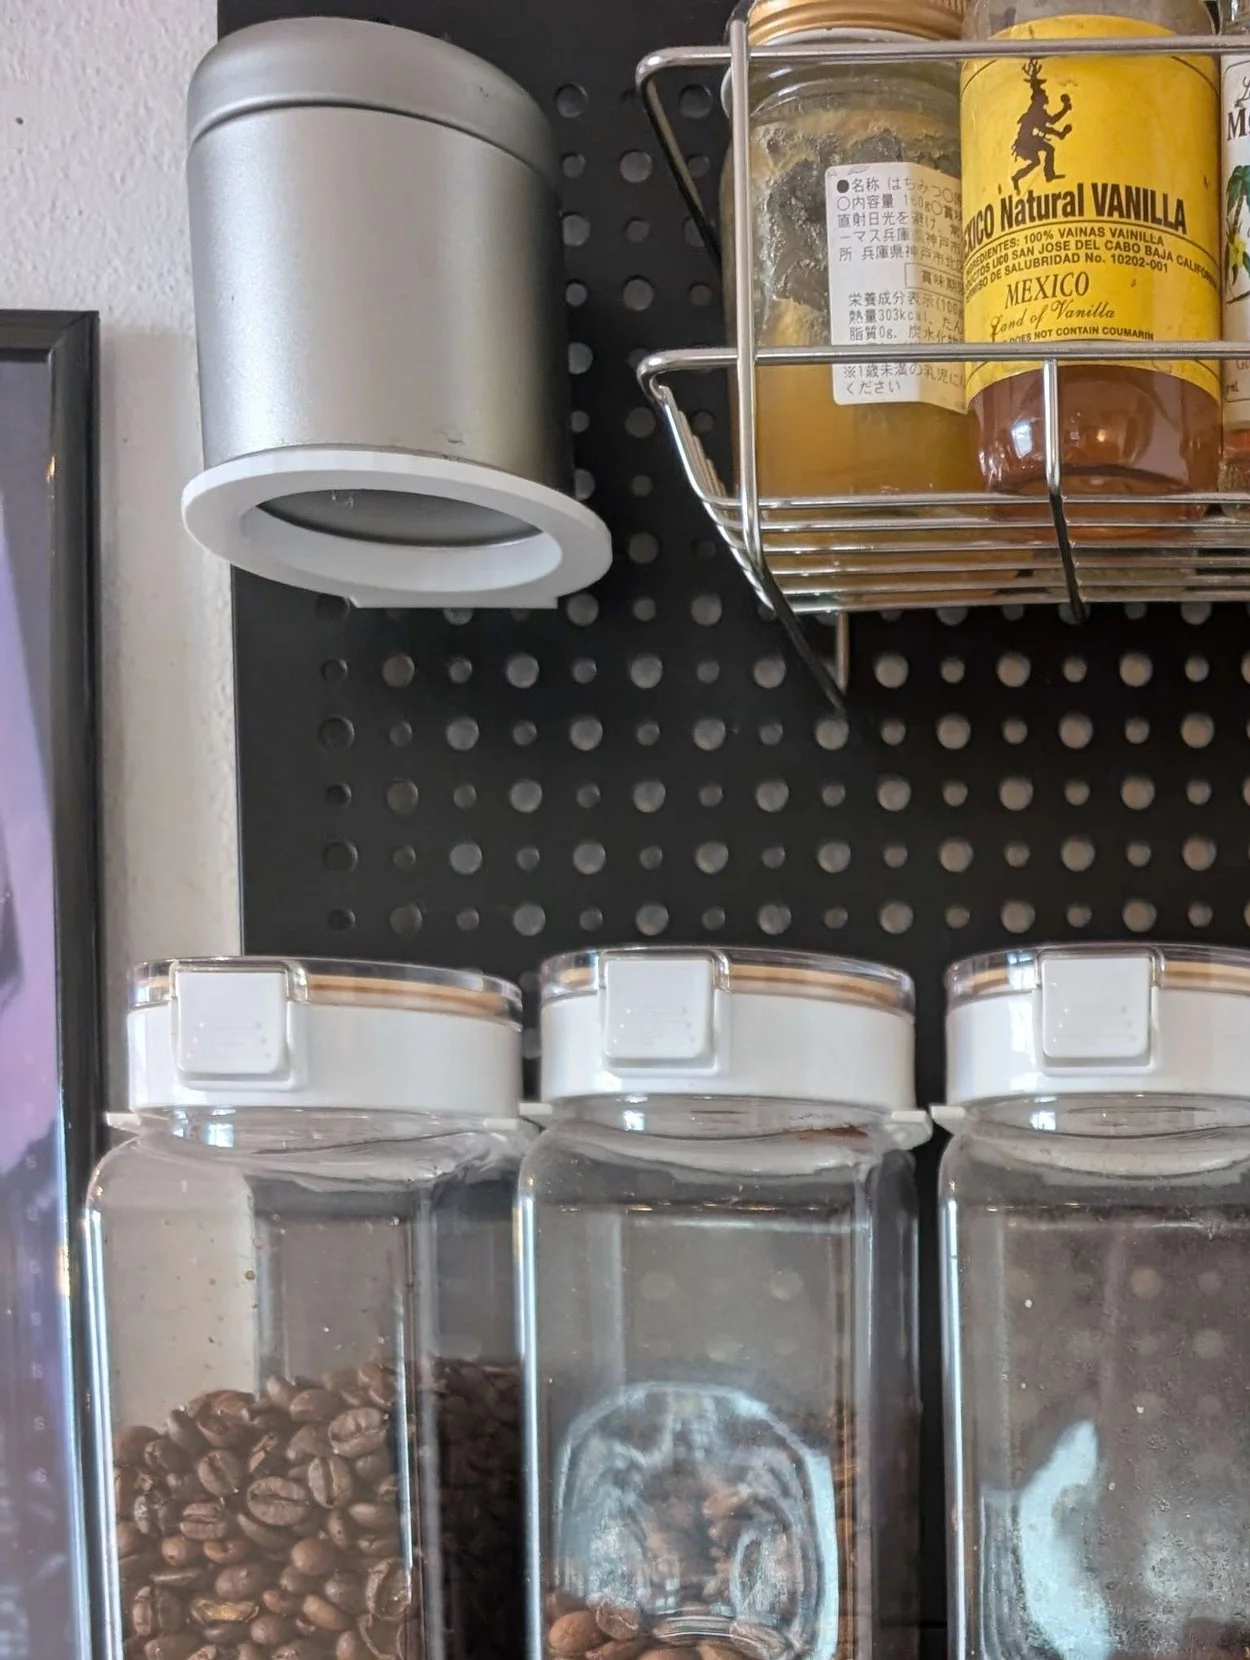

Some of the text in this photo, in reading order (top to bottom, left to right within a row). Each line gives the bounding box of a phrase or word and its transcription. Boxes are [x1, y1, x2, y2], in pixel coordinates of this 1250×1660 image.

[1000, 182, 1084, 232] Natural
[1091, 182, 1188, 235] VANILLA
[1024, 226, 1164, 247] 100% VAINAS VAINILLA
[1011, 246, 1034, 260] SAN
[1038, 240, 1070, 255] JOSE
[1075, 240, 1100, 250] DEL
[1104, 240, 1140, 254] CABO
[1144, 244, 1174, 262] BAJA
[990, 252, 1168, 284] DE SALUBRIDAD No. 10202-001
[1004, 271, 1090, 310] MEXICO
[1029, 304, 1048, 329] of
[1050, 299, 1116, 320] Vanilla
[1034, 328, 1053, 338] NOT
[1055, 326, 1100, 336] CONTAIN
[1102, 326, 1154, 341] COUMARIN
[846, 381, 901, 396] ください
